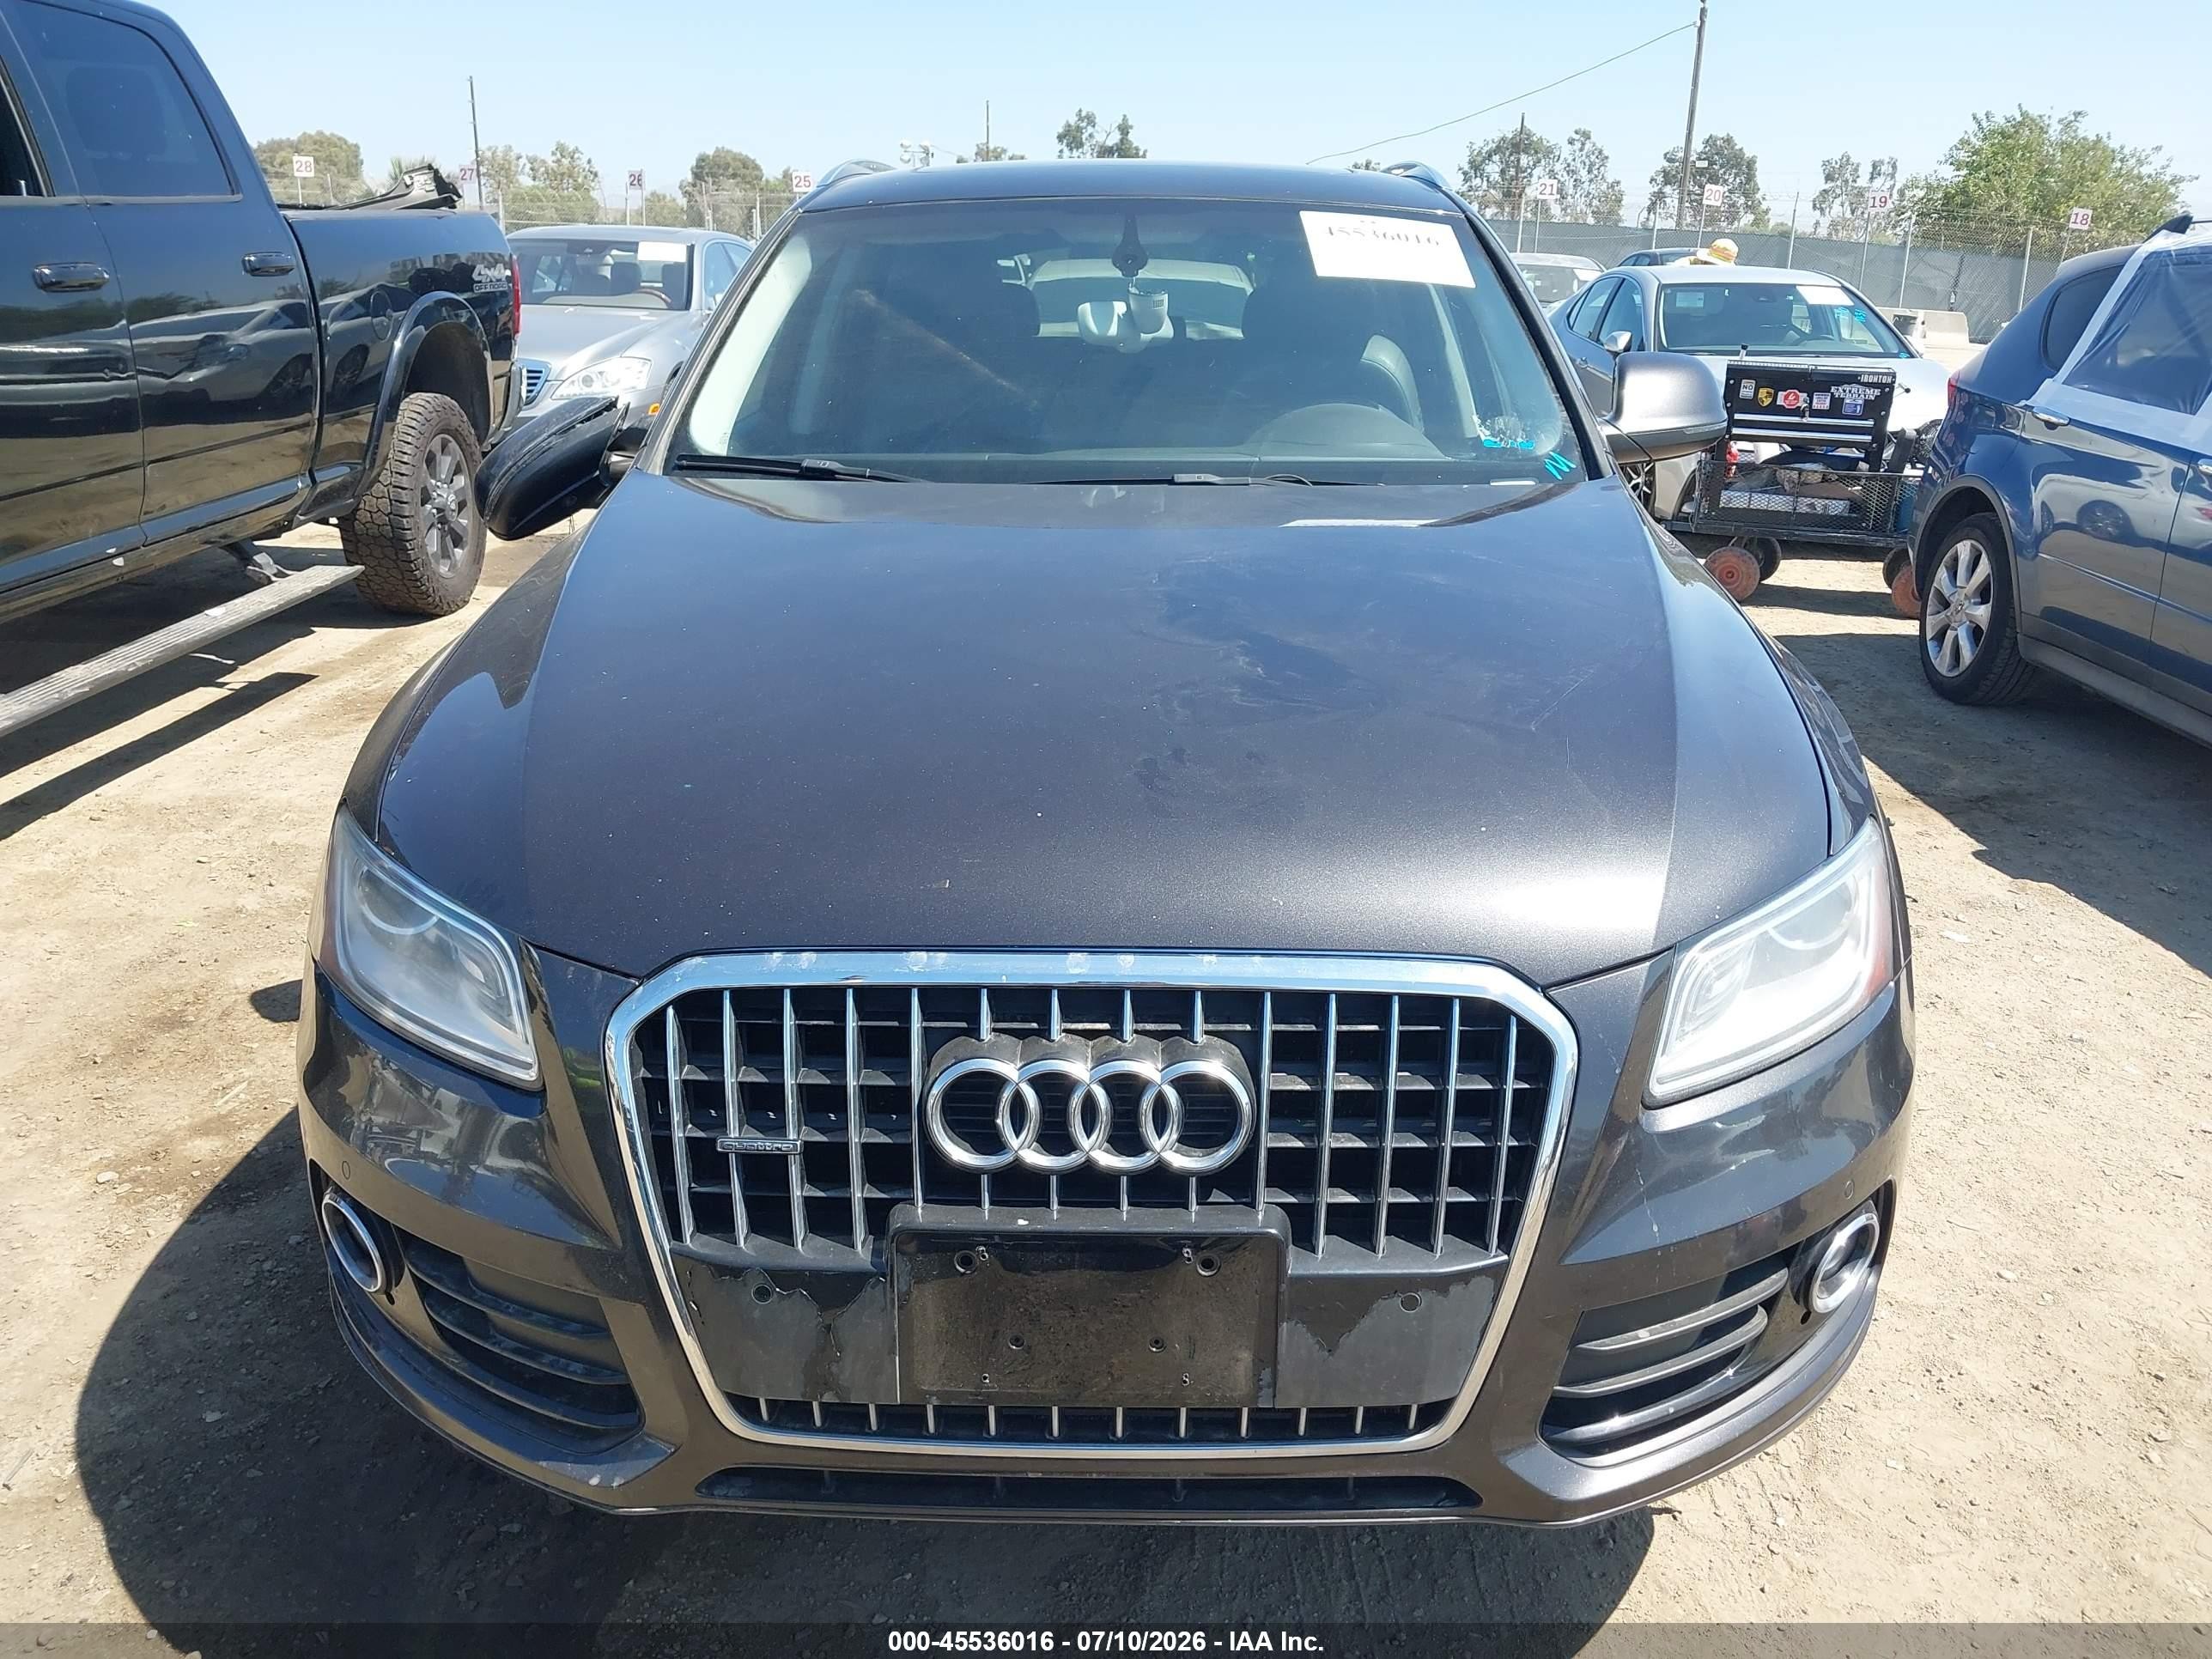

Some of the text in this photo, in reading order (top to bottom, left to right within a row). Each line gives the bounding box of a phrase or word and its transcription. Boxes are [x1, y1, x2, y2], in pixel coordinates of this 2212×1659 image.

[295, 160, 313, 173] 28
[459, 167, 475, 181] 27
[629, 173, 642, 187] 26
[794, 174, 811, 188] 25
[1539, 182, 1556, 196] 21
[1705, 188, 1722, 203] 20
[1869, 195, 1888, 210] 19
[2071, 211, 2090, 226] 18
[1860, 374, 1893, 384] IRONTON
[1830, 386, 1881, 396] EXTREME
[1833, 392, 1876, 401] TERRAIN
[723, 1141, 793, 1152] quattro
